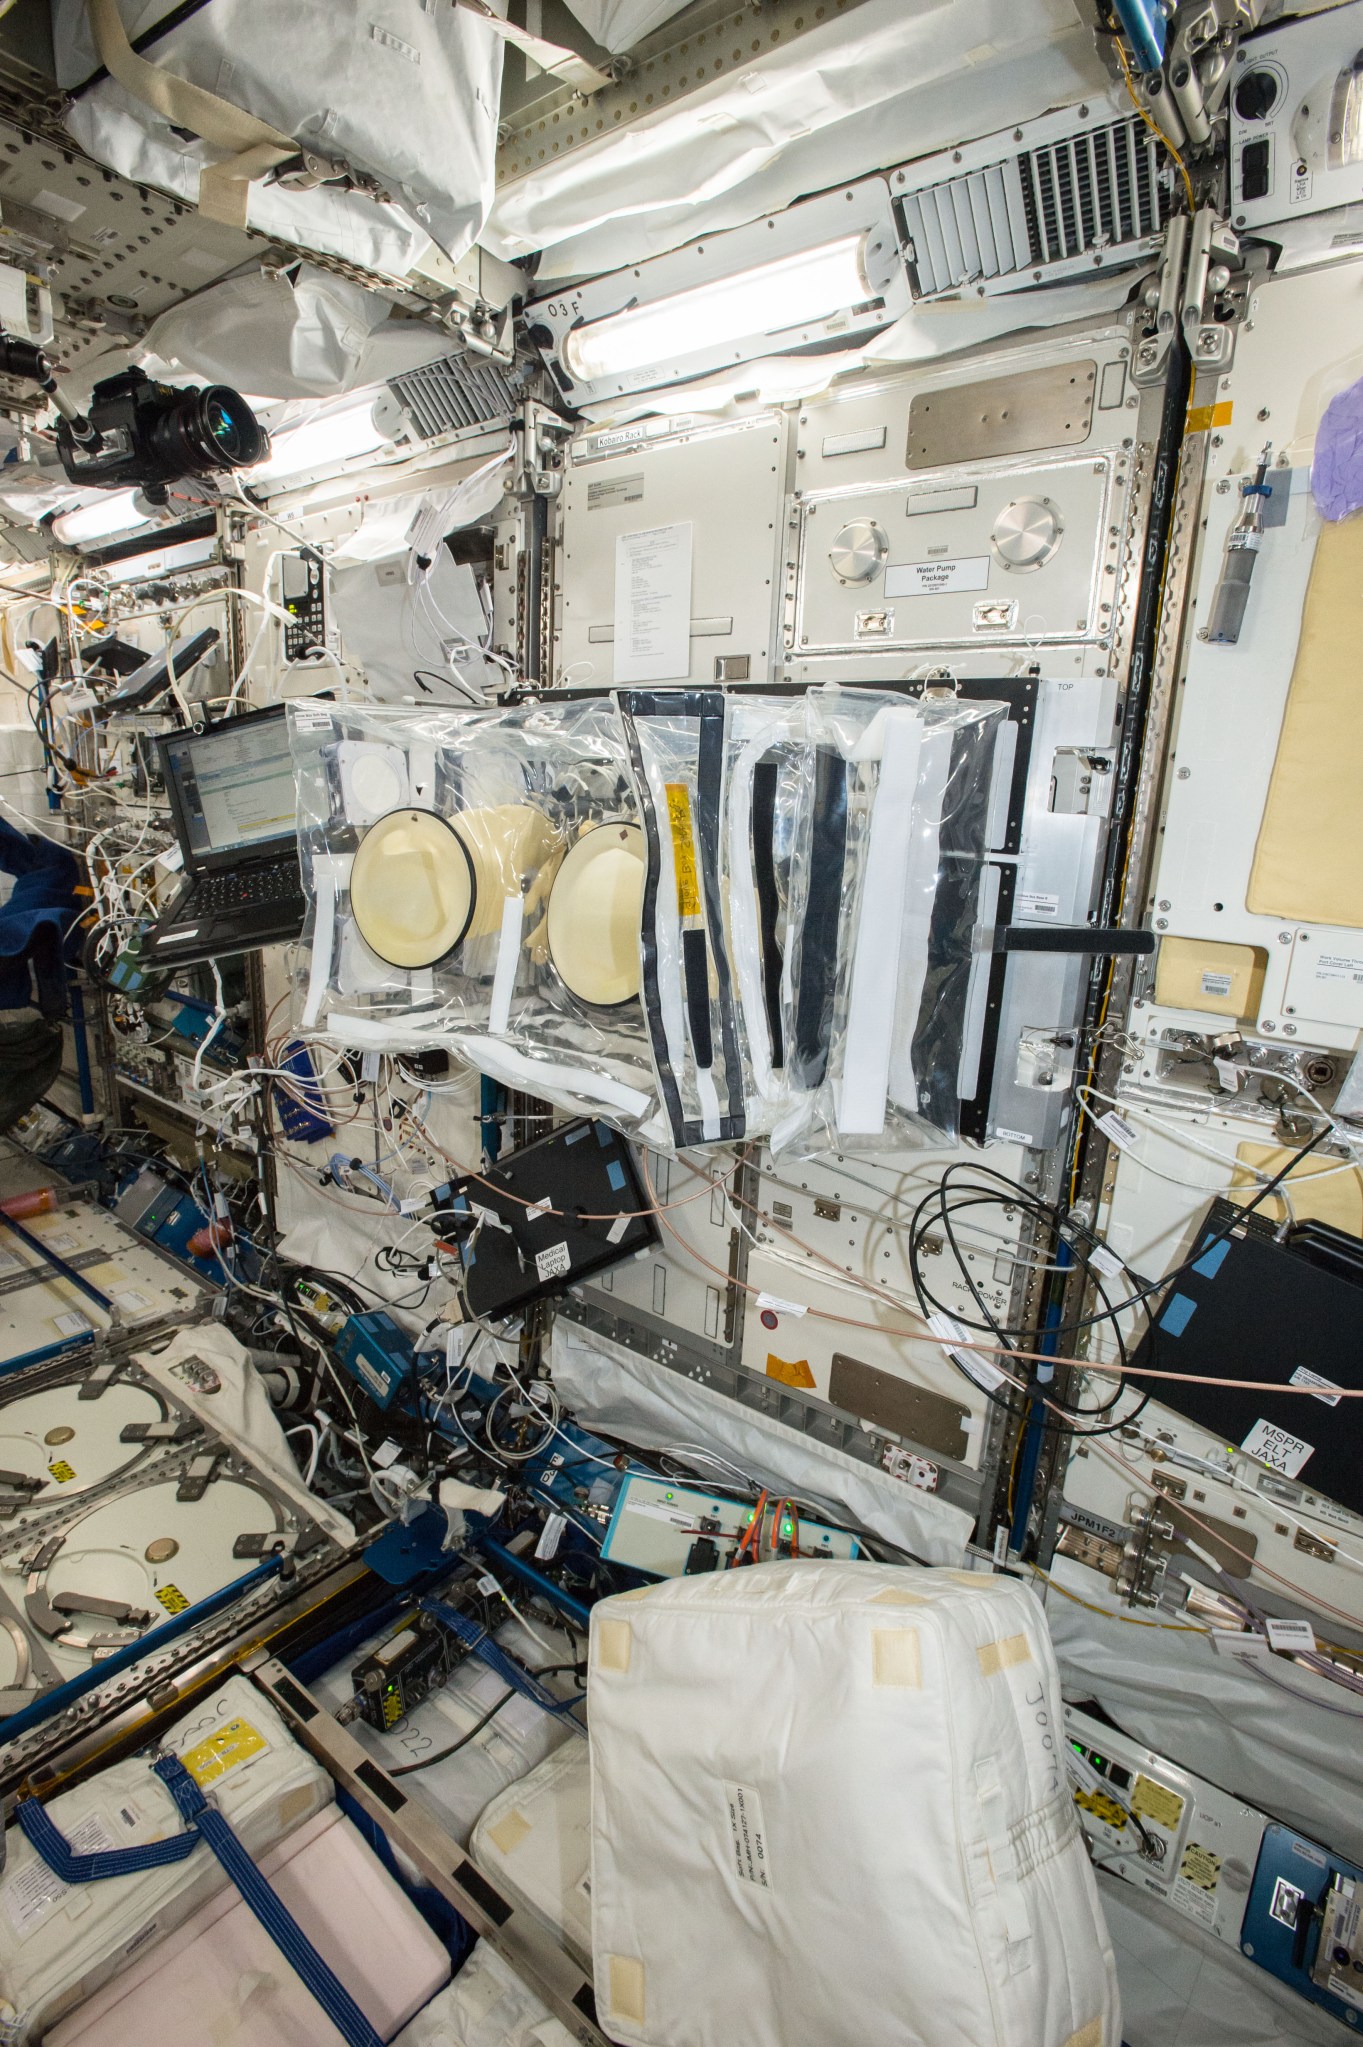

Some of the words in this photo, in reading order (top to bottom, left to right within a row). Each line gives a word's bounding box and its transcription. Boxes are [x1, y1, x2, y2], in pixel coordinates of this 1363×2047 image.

[1260, 49, 1279, 60] OUTPUT
[1238, 136, 1252, 145] LAMP
[1252, 132, 1269, 141] POWER
[599, 434, 625, 448] Kobairo
[625, 430, 642, 441] Rack
[936, 564, 956, 573] Pump
[921, 573, 949, 582] Package
[1057, 683, 1074, 691] TOP
[1002, 1130, 1026, 1141] BOTTOM
[537, 1245, 566, 1262] Medical
[541, 1254, 566, 1270] Laptop
[545, 1263, 566, 1278] JAXA
[977, 1290, 1007, 1306] POWER
[1261, 1425, 1305, 1454] MSPR
[1262, 1439, 1292, 1458] ELT
[1251, 1447, 1287, 1472] JAXA
[1070, 1512, 1116, 1538] JPM1F2
[755, 1832, 764, 1860] 0074
[1189, 1847, 1217, 1867] CAUTION
